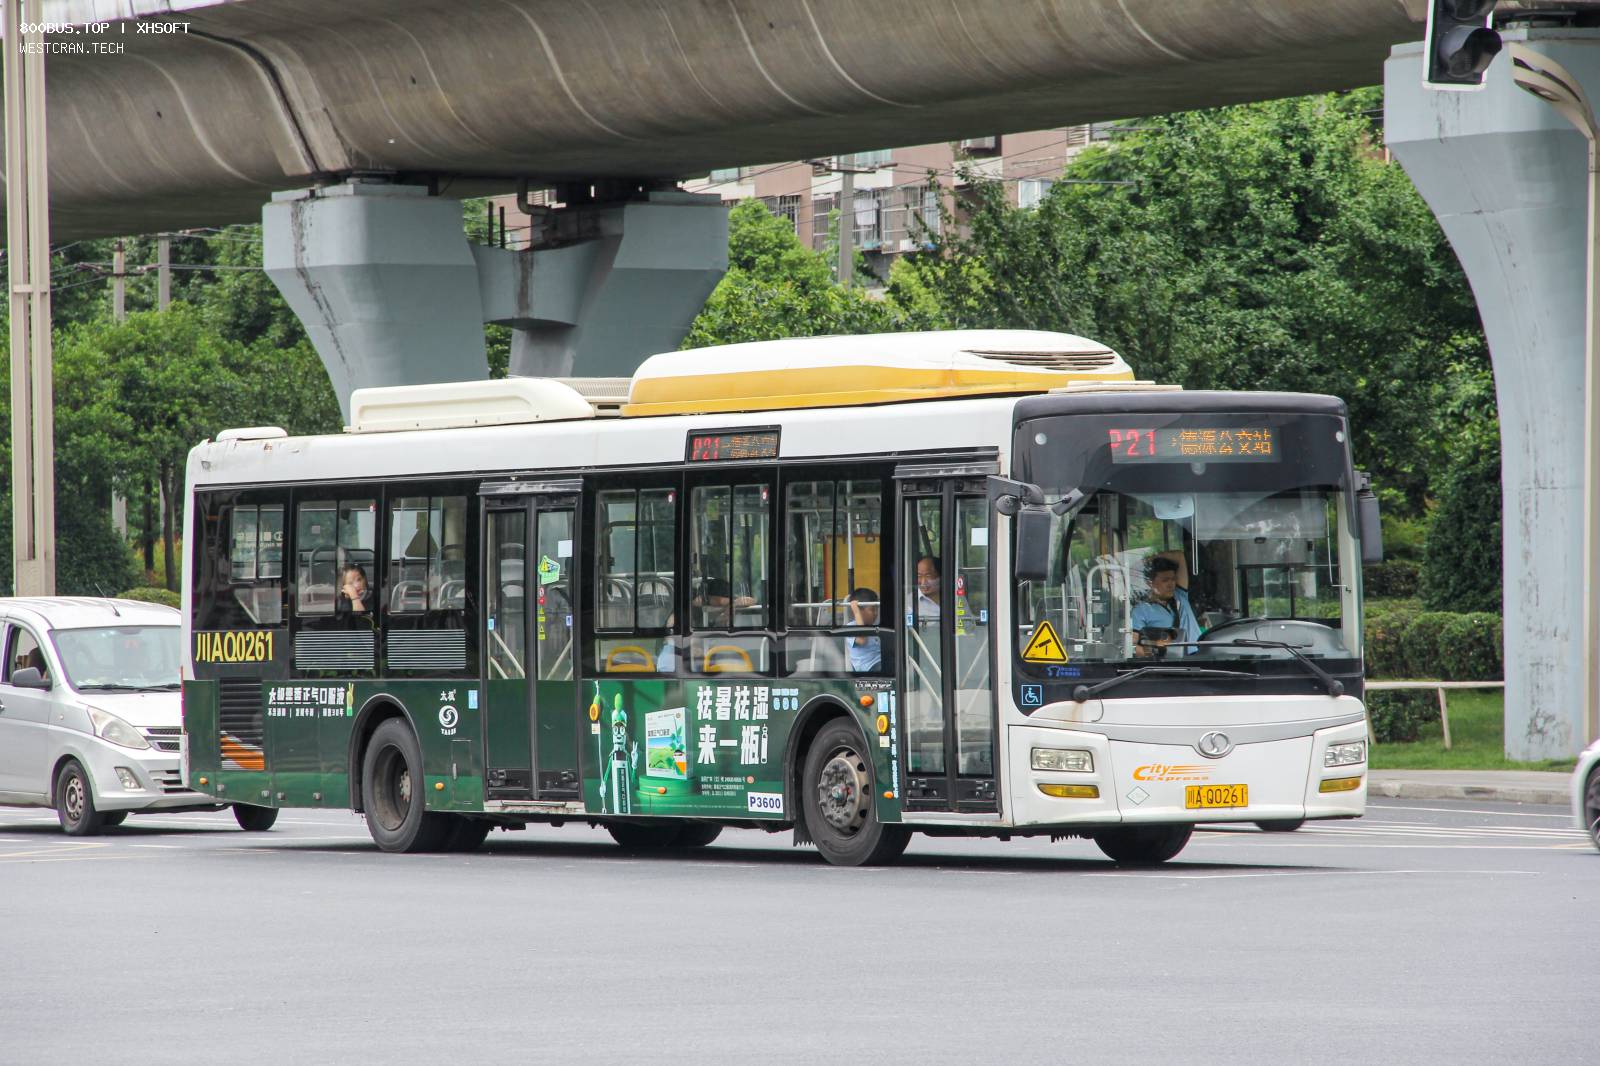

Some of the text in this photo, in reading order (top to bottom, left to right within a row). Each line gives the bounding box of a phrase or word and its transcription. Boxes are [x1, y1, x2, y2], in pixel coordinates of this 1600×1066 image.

[1108, 428, 1156, 456] P21
[195, 631, 274, 663] 川AQ0261
[696, 685, 769, 721] 祛暑祛湿
[697, 724, 761, 765] 来一瓶
[1132, 763, 1169, 781] City
[749, 796, 781, 809] P3600
